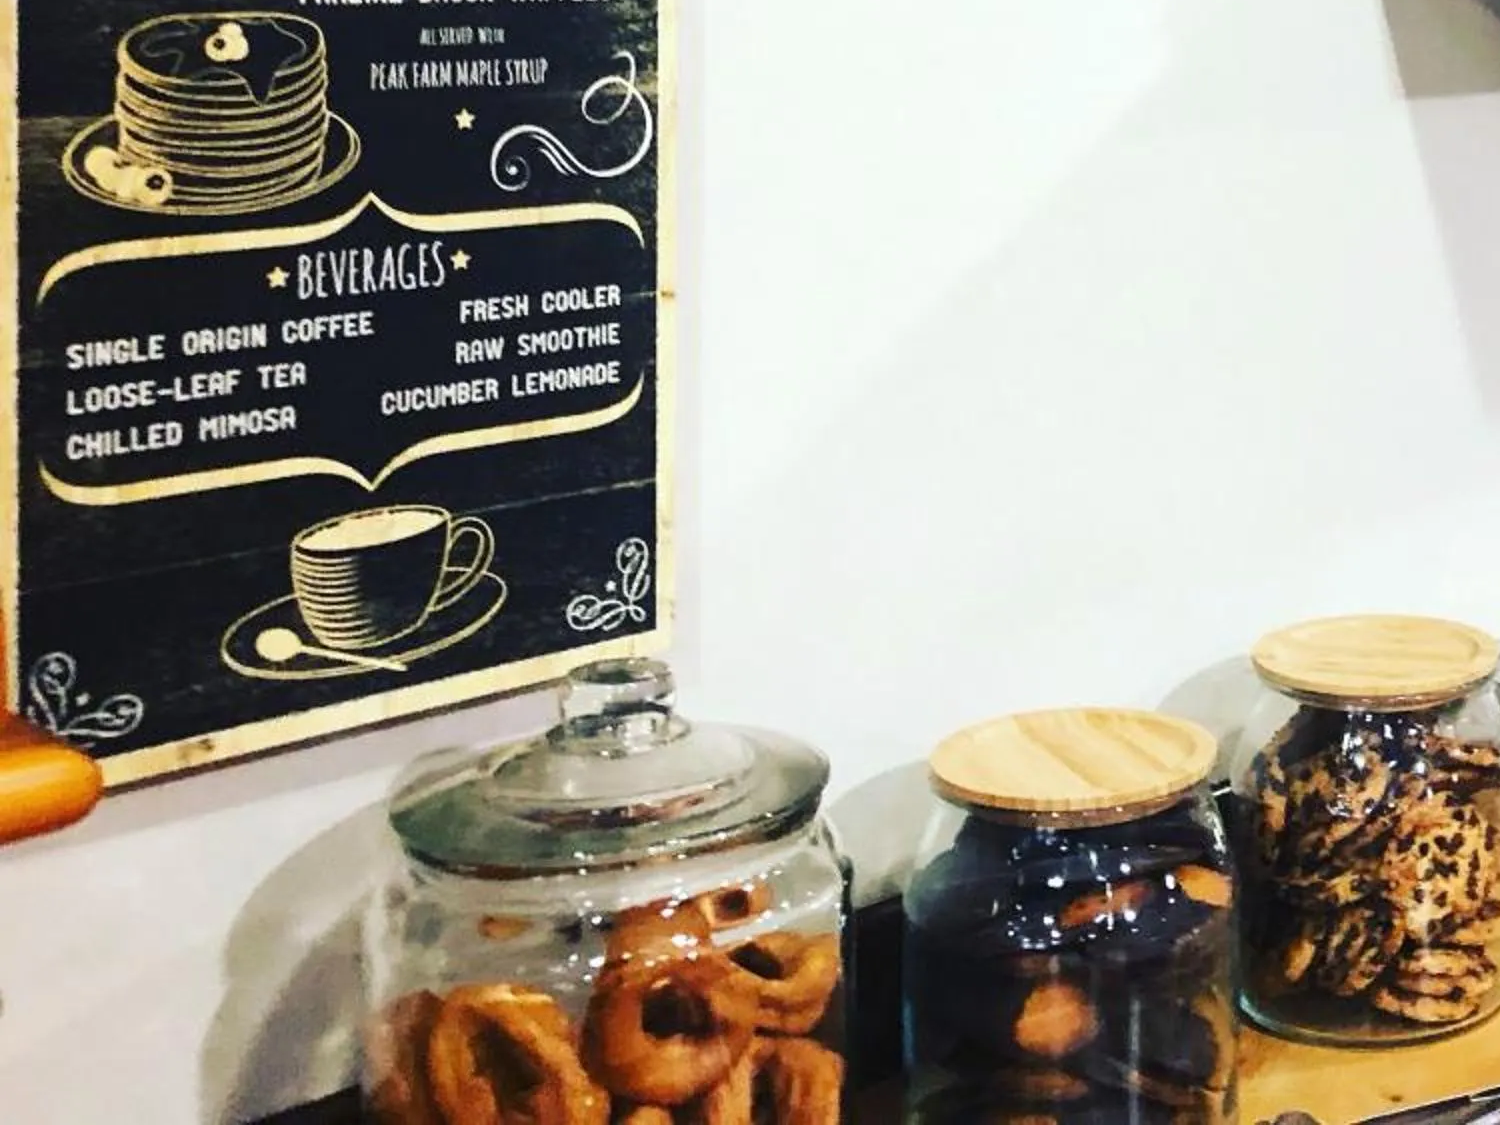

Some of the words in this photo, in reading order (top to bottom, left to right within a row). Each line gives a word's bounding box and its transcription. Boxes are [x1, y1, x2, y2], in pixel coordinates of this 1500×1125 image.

[370, 60, 409, 92] PEAK
[412, 59, 452, 89] FARM
[455, 57, 501, 87] MAPLE
[505, 56, 549, 87] SYRUP
[297, 240, 447, 301] BEVERAGES
[459, 295, 529, 325] FRESH
[542, 285, 622, 315] COOLER
[65, 334, 165, 371] SINGLE
[182, 323, 267, 357] ORIGIN
[281, 311, 375, 347] COFFEE
[455, 336, 505, 366] RAW
[518, 323, 621, 356] SMOOTHIE
[65, 370, 240, 416] LOOSE-LEAF
[257, 362, 307, 393] TEA
[381, 378, 499, 416] CUCUMBER
[511, 361, 621, 397] LEMONADE
[65, 424, 183, 461] CHILLED
[199, 406, 296, 443] MIMOSA
